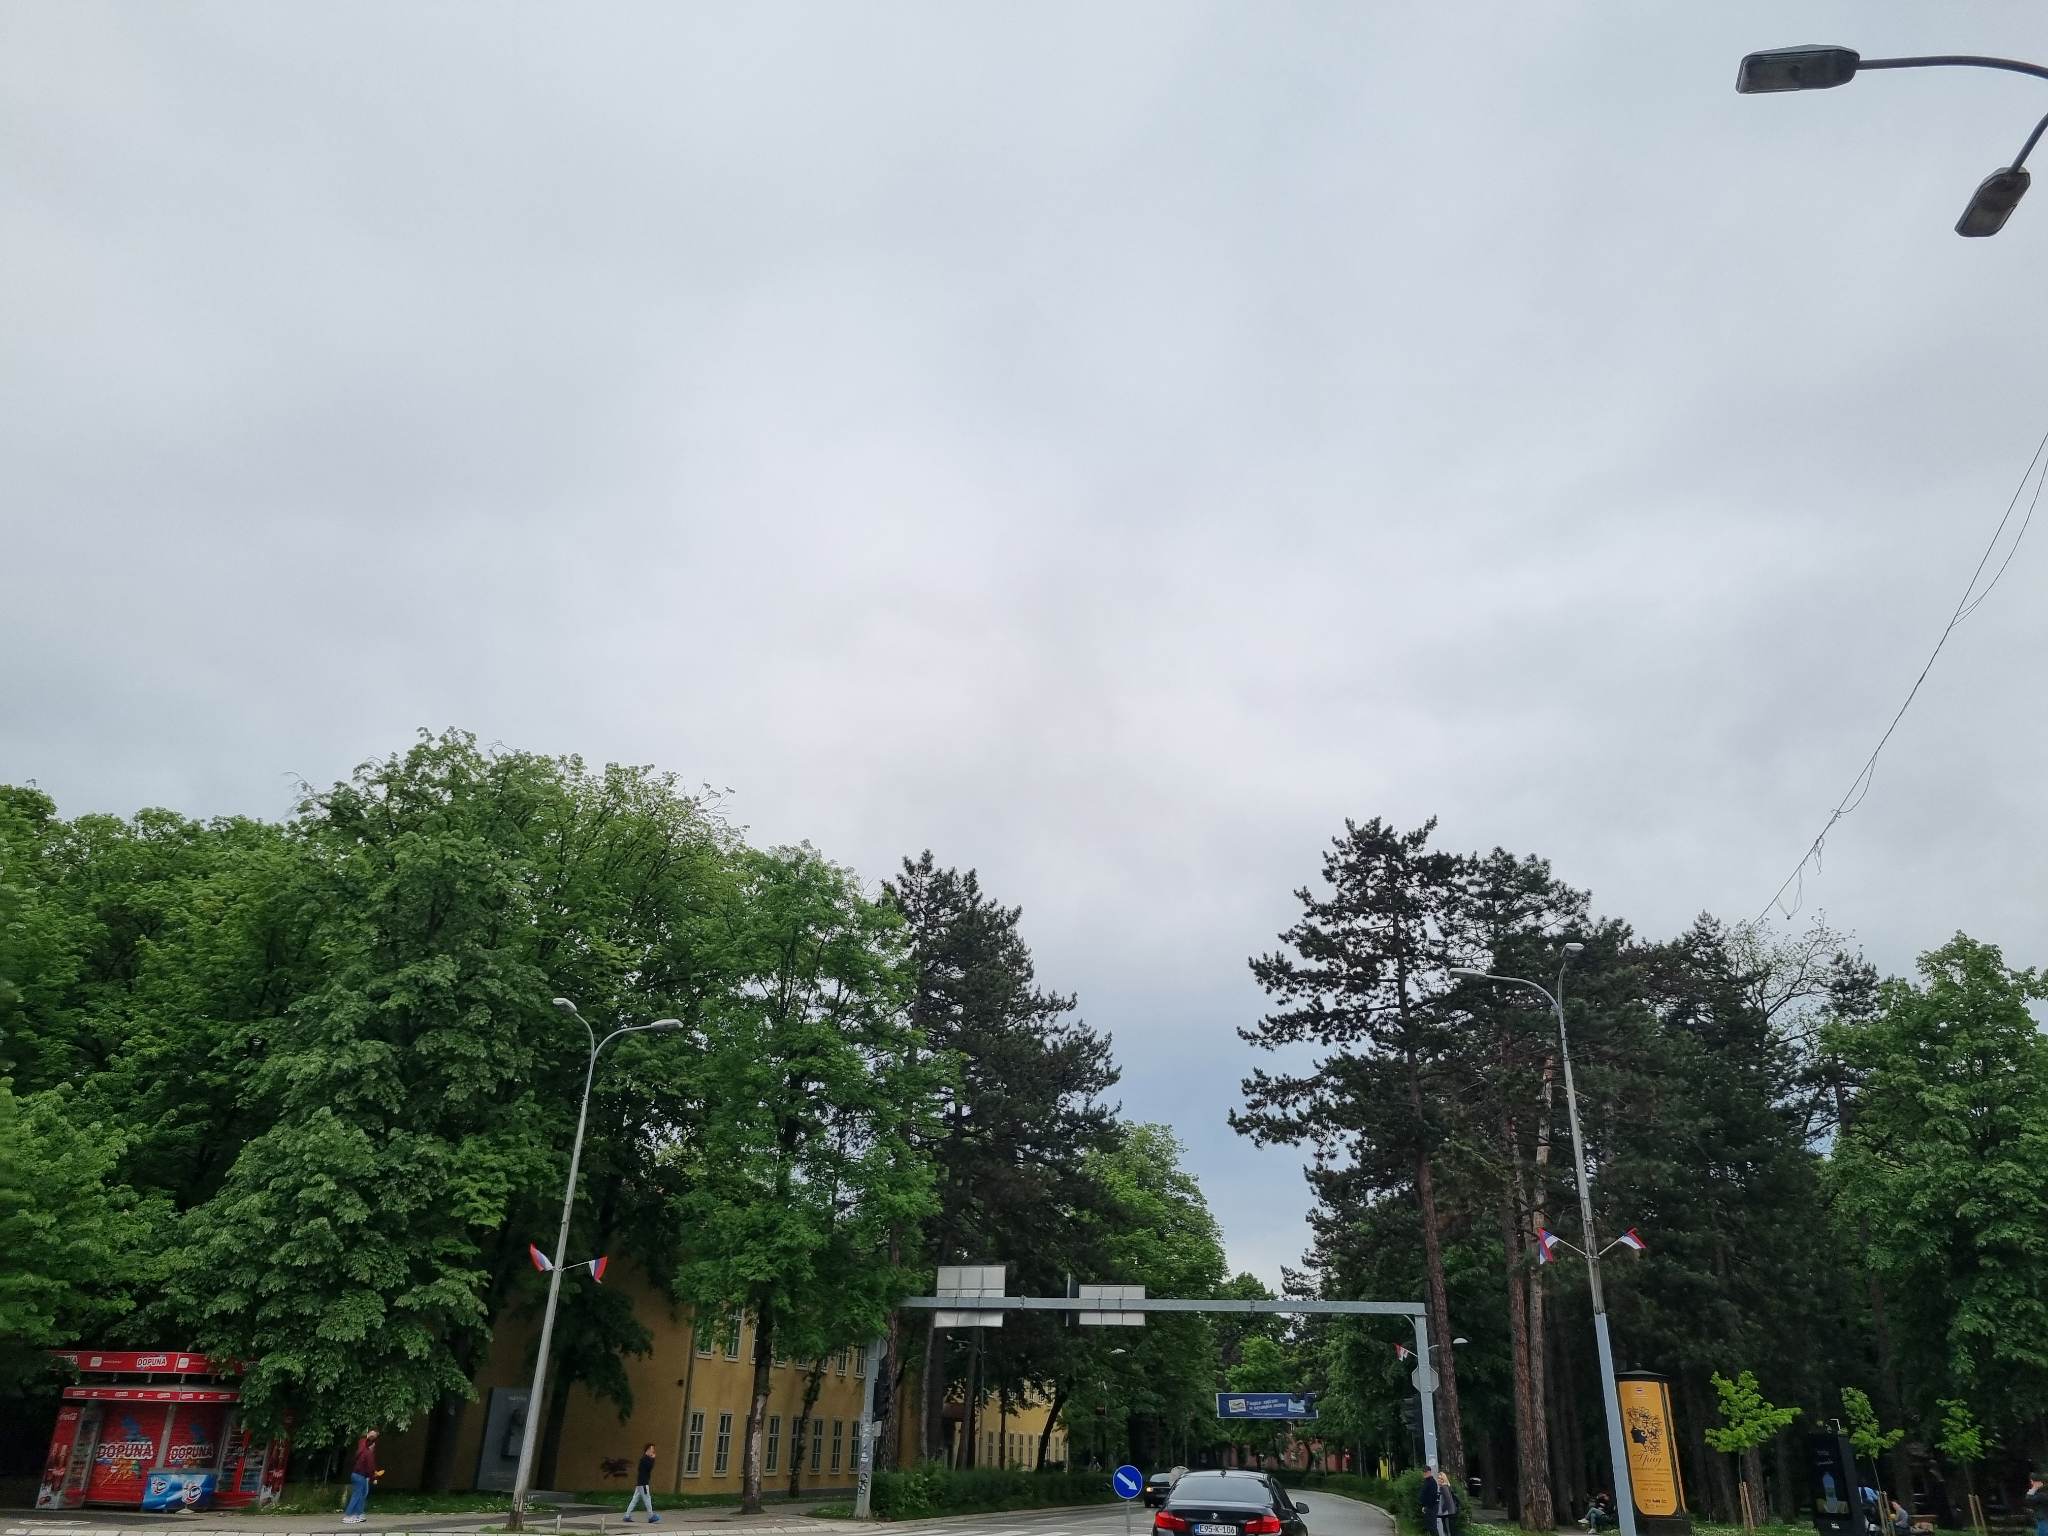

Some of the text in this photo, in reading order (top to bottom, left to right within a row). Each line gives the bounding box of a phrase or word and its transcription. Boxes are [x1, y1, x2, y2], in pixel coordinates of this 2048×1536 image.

[138, 1358, 167, 1367] DOPUNA
[97, 1443, 153, 1458] DOPUNA
[170, 1445, 213, 1459] DOPUNA
